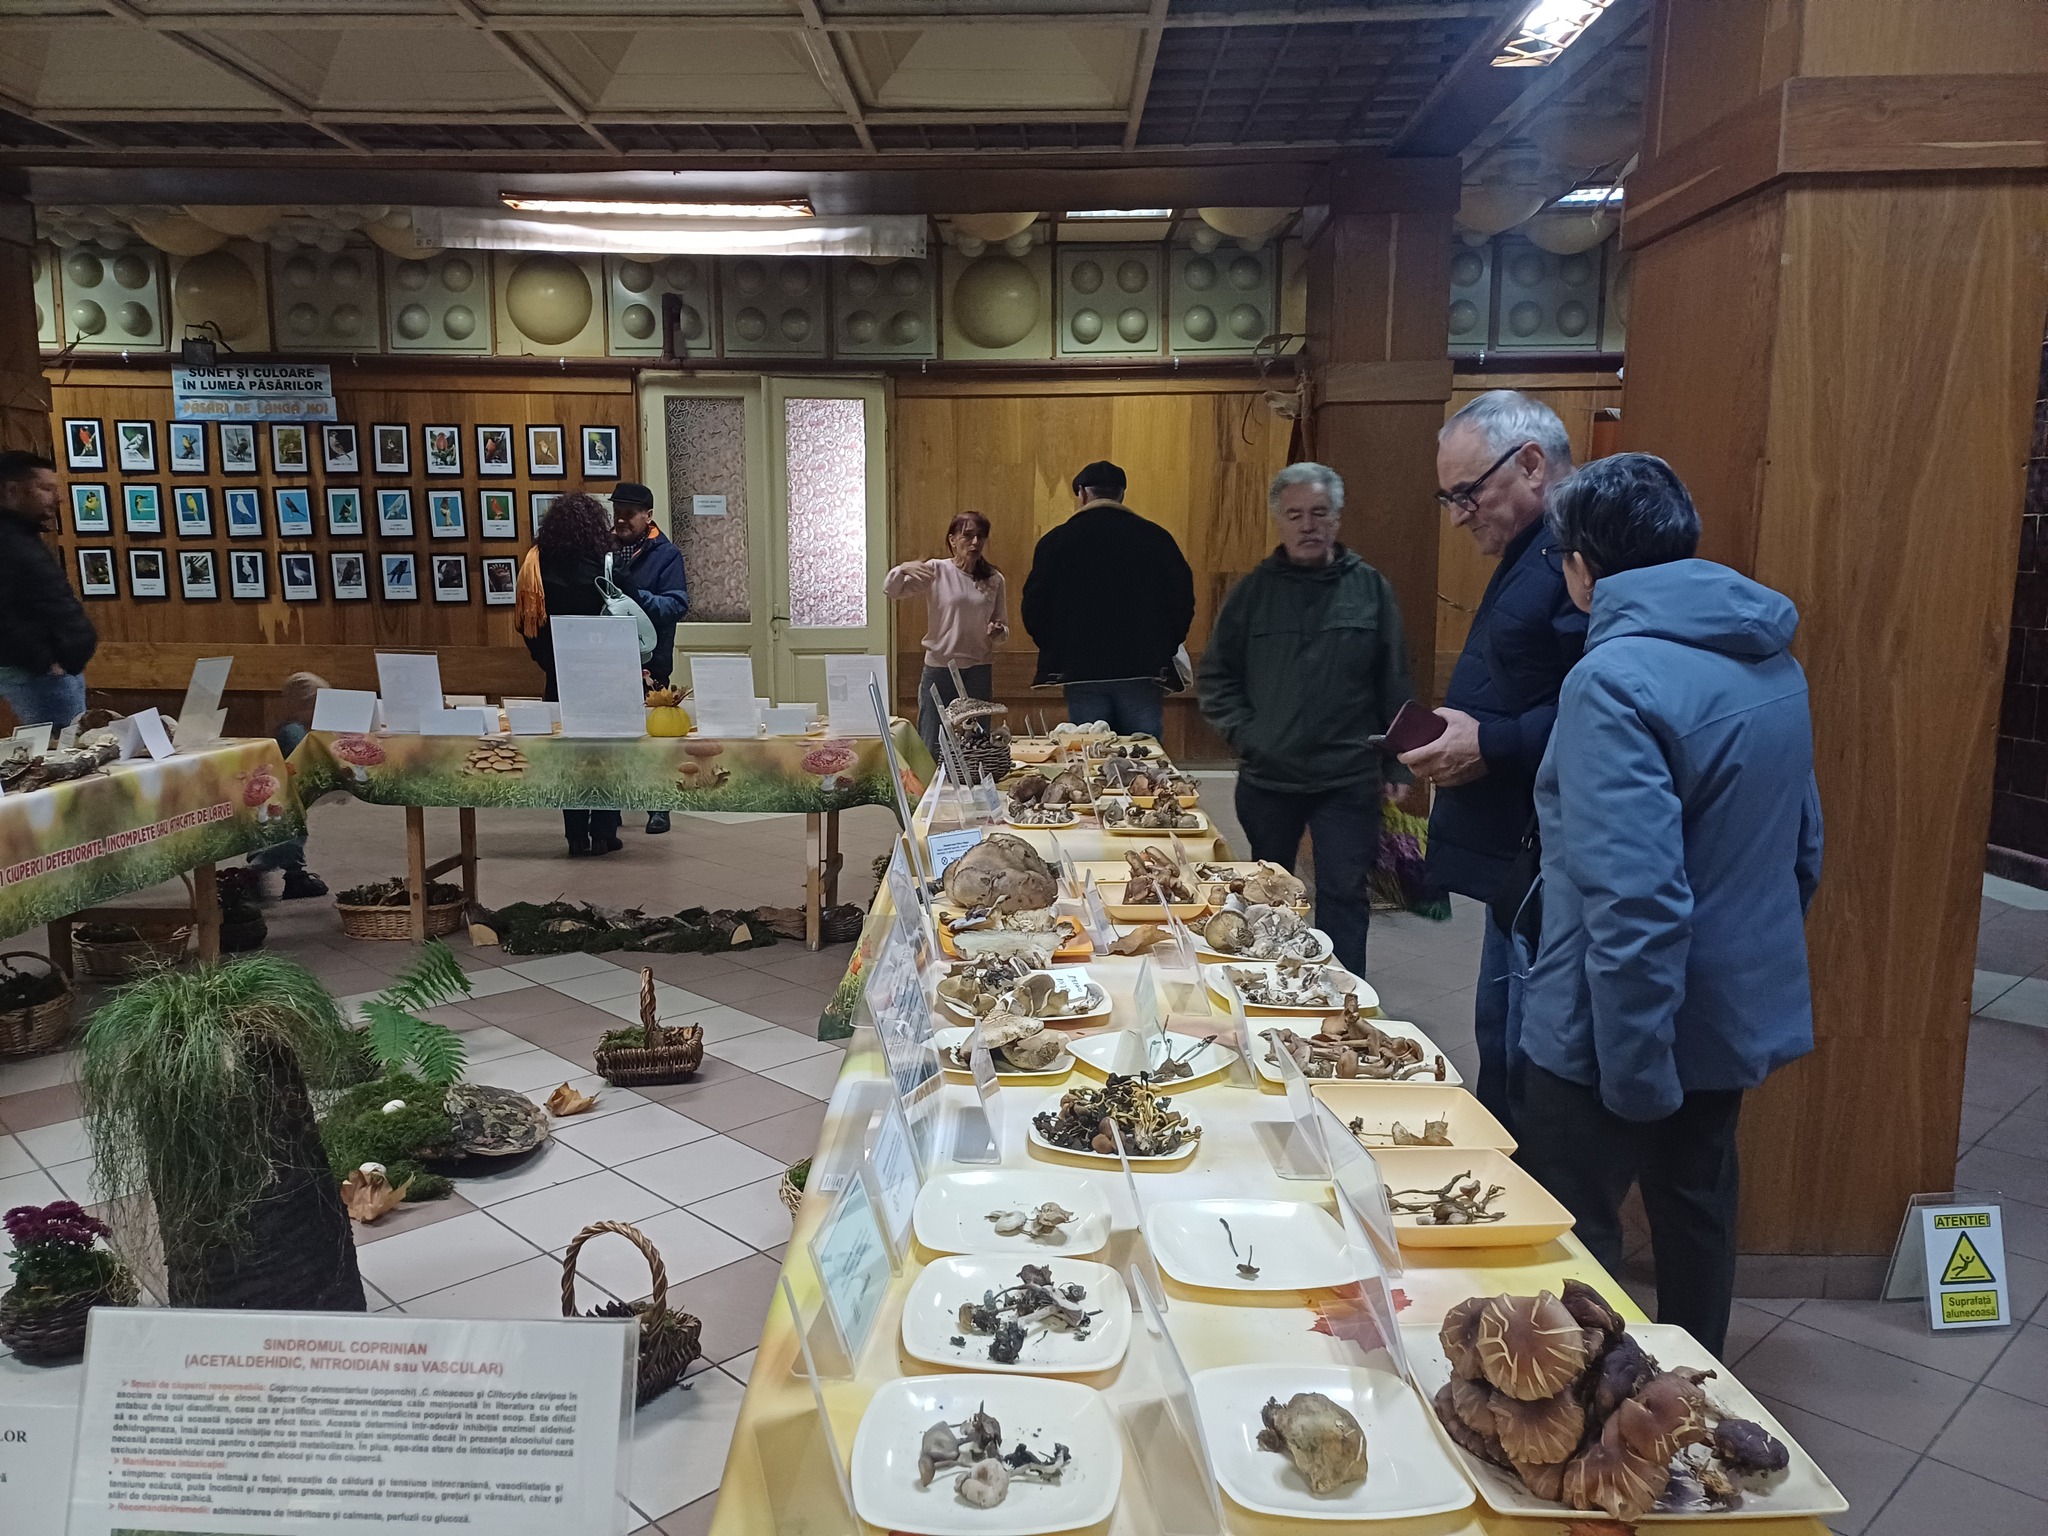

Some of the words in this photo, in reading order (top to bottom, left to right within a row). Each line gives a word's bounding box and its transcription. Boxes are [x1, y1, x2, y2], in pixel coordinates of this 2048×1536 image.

[188, 368, 234, 378] SUNET
[254, 368, 315, 378] CULOARE
[182, 378, 196, 390] ÎN
[201, 381, 245, 390] LUMEA
[250, 379, 323, 390] PĂSĂRILOR
[234, 403, 250, 414] DE
[306, 403, 328, 414] NOI
[6, 859, 43, 884] CIUPERCI
[46, 840, 105, 871] DETERIORATE,
[107, 825, 156, 852] INCOMPLETE
[156, 821, 168, 837] SAU
[197, 809, 208, 823] DE
[1946, 1308, 1996, 1319] alunecoasă
[262, 1338, 346, 1352] SINDROMUL
[349, 1341, 428, 1354] COPRINIAN
[310, 1357, 389, 1371] NITROIDIAN
[393, 1362, 418, 1372] sau
[421, 1360, 503, 1376] VASCULAR)
